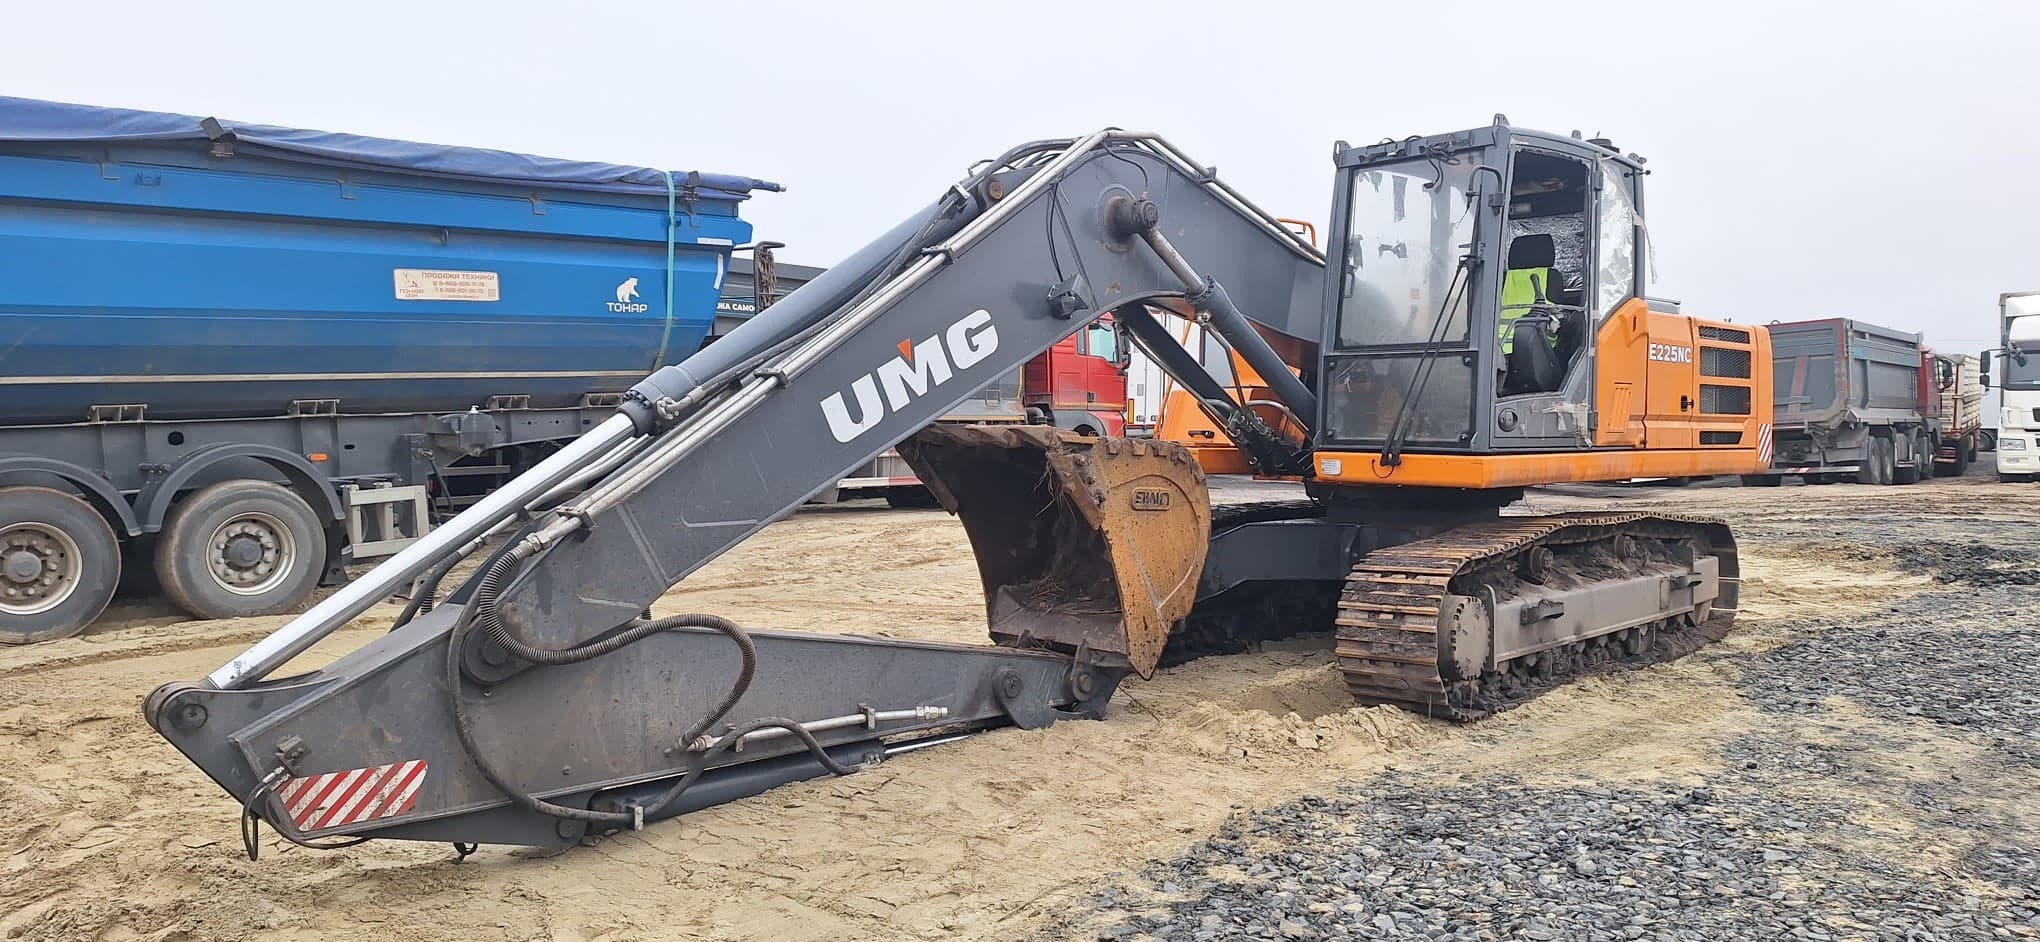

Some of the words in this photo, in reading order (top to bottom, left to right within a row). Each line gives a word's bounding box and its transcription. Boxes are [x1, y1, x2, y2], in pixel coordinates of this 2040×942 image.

[421, 271, 460, 280] ПРОДАЖА
[462, 273, 495, 281] ТЕХНИКИ
[606, 302, 648, 314] ТОНАР
[1649, 343, 1692, 364] E225NC
[820, 309, 999, 443] UMG
